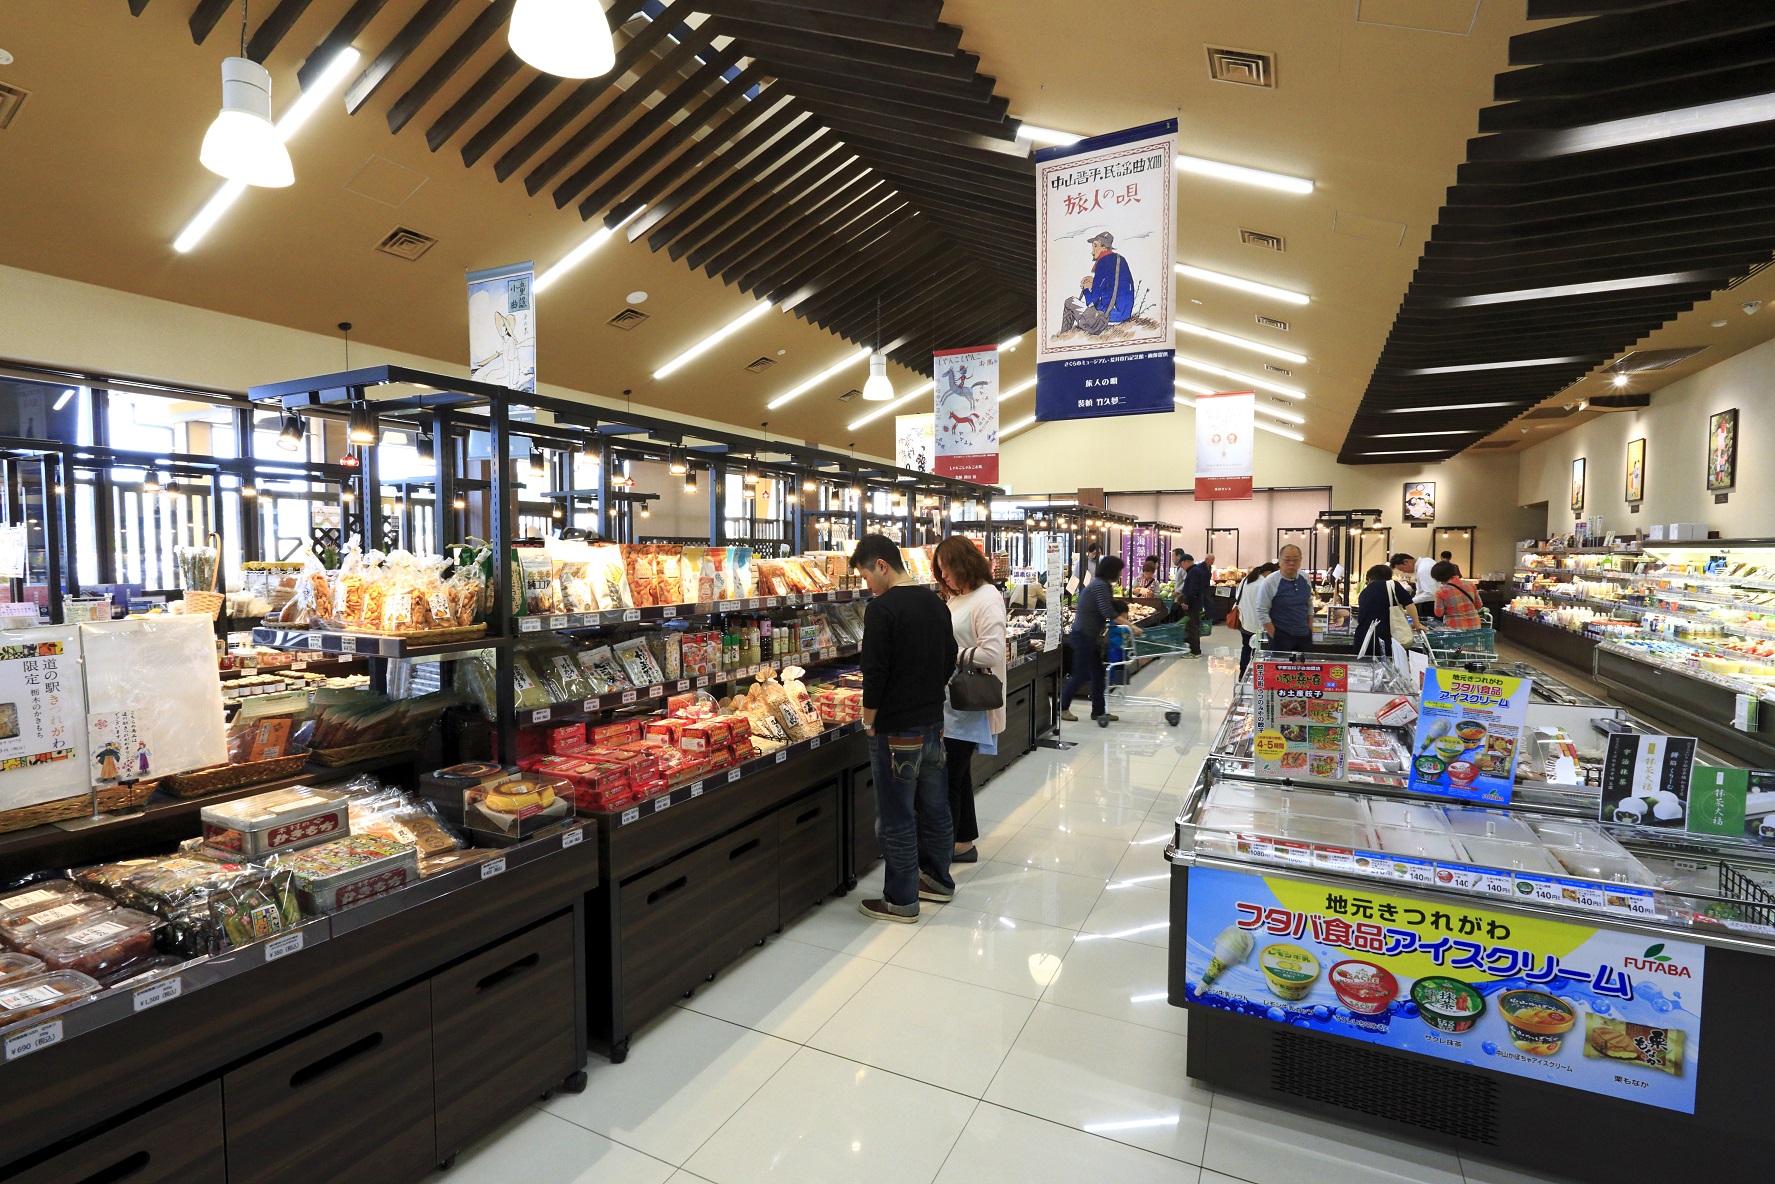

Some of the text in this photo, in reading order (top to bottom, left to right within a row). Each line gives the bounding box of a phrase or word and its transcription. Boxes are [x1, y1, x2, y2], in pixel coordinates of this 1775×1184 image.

[1063, 183, 1141, 216] 旅人の唄
[23, 660, 41, 686] 限定
[1452, 673, 1504, 686] 地元きつれがわ
[1438, 690, 1511, 709] アイスクリーム
[1450, 681, 1503, 697] フタバ食品
[31, 689, 44, 739] 栃木のかきもち
[43, 658, 66, 749] 道の駅きつれがわ
[1641, 757, 1656, 792] 抹茶大福
[1712, 788, 1726, 827] 抹茶大福
[273, 821, 335, 847] かきもち
[278, 821, 310, 834] 木村の
[1325, 893, 1512, 941] 地元きつれがわ
[1624, 956, 1692, 979] FUTABA
[1439, 991, 1456, 1010] 抹茶
[1425, 1034, 1462, 1048] サクレ抹茶
[1496, 1050, 1573, 1073] 中山かぼちゃアイスクリーム
[1613, 1075, 1650, 1089] 栗もなか
